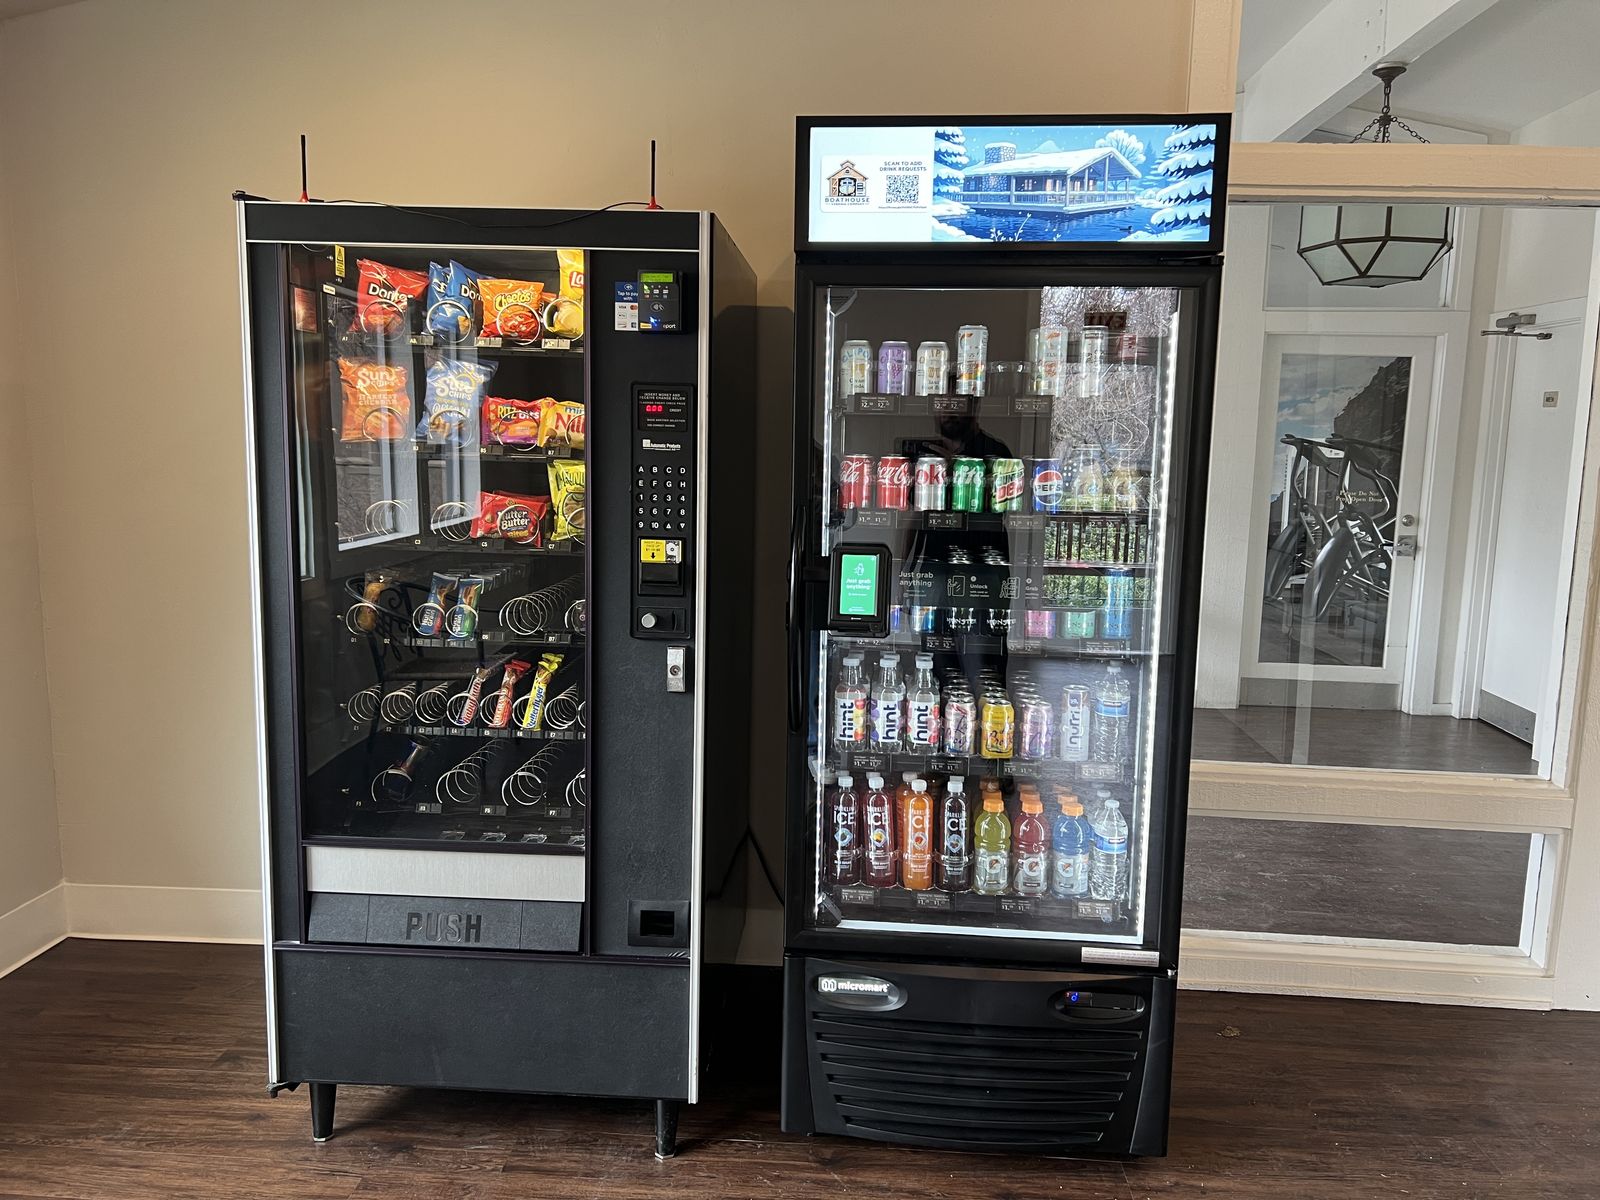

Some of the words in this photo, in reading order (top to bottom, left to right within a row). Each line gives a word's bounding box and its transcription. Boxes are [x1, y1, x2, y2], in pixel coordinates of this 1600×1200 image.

[494, 289, 533, 311] Cheetos
[449, 391, 472, 400] CHIPS
[498, 405, 517, 419] RITZ
[501, 518, 530, 530] Butter
[916, 572, 934, 580] grab
[840, 702, 854, 739] hint
[882, 704, 897, 740] hint
[914, 705, 929, 742] hint
[834, 812, 855, 825] ICE
[867, 812, 888, 825] ICE
[406, 912, 482, 943] PUSH
[838, 981, 888, 992] micromart
